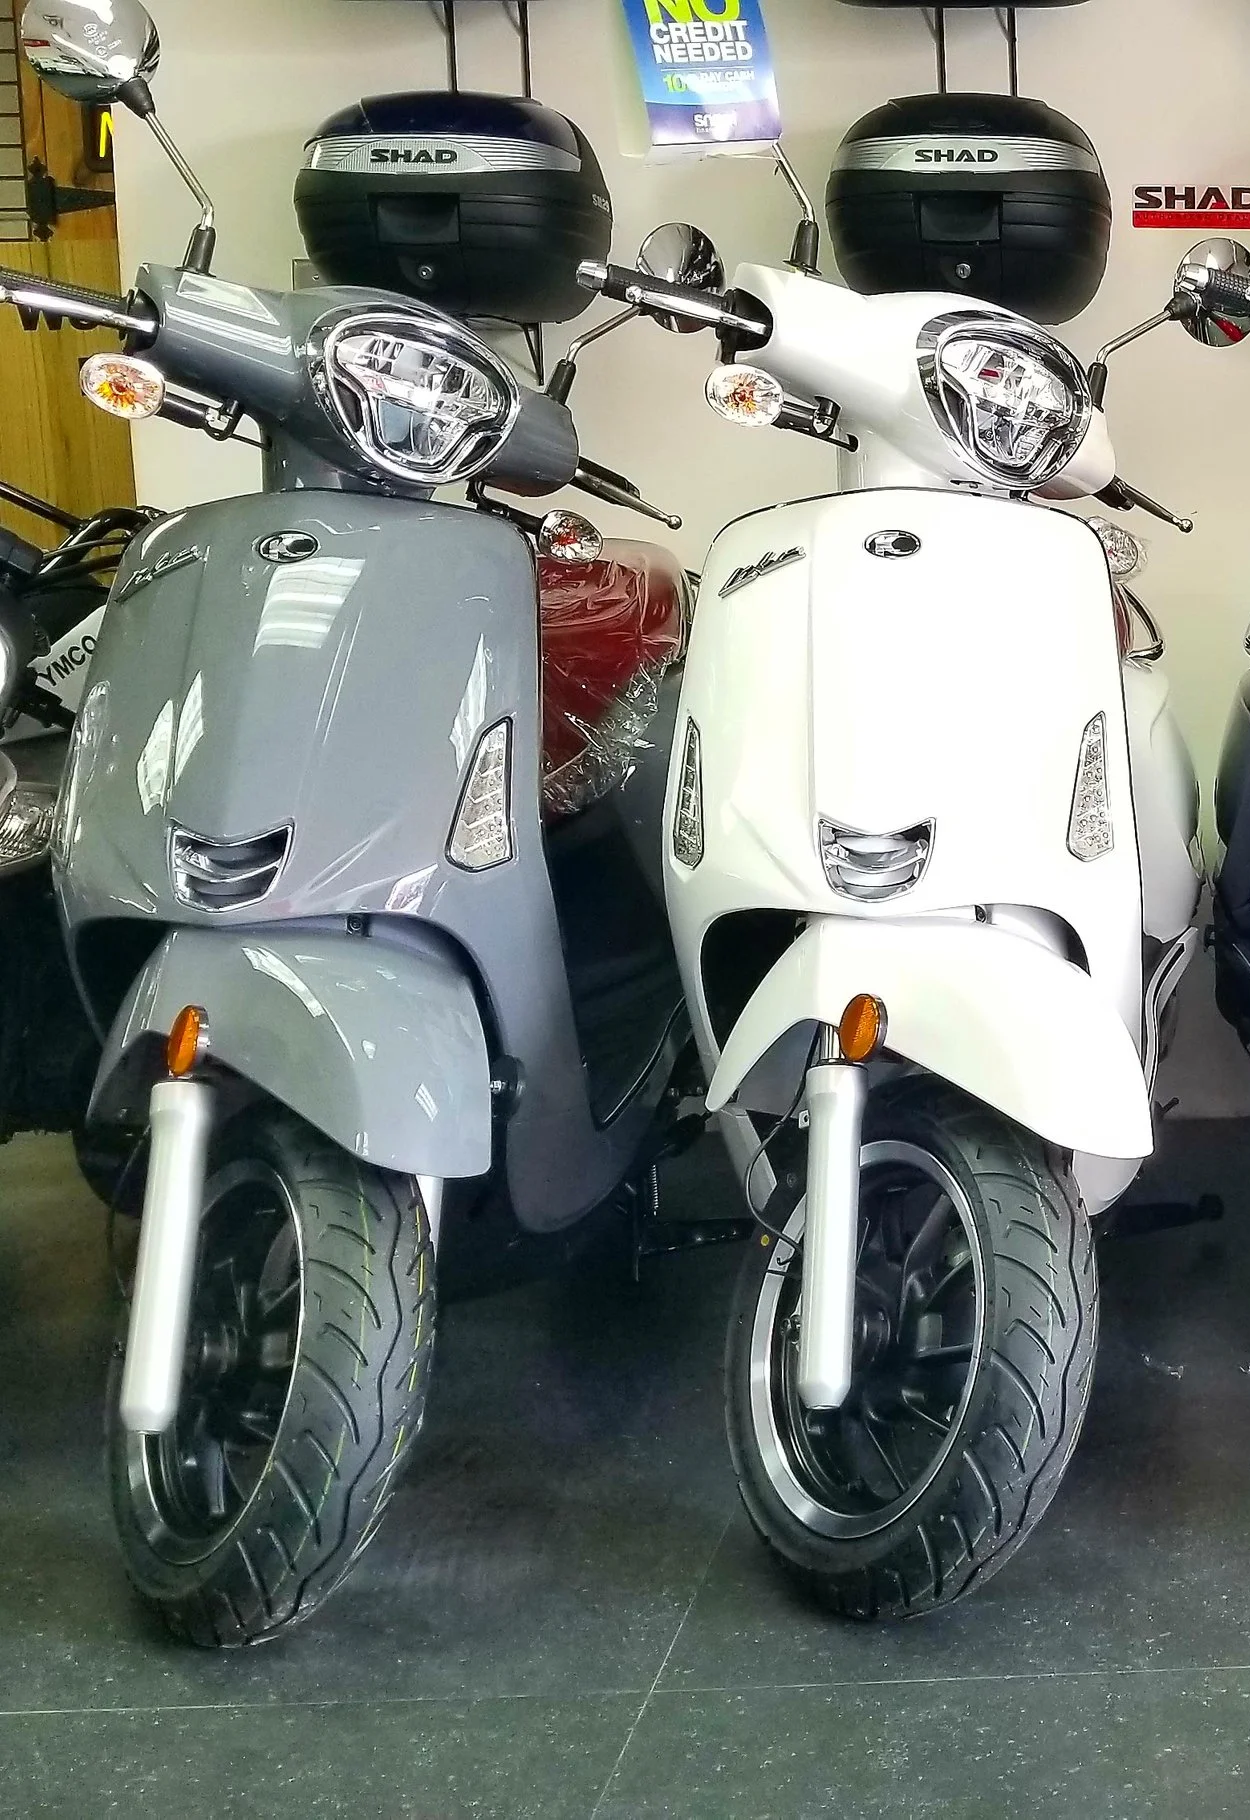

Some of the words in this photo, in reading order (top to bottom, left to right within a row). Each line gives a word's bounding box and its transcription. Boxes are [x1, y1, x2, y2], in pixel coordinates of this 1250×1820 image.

[650, 21, 747, 43] CREDIT
[652, 42, 753, 64] NEEDED
[370, 148, 458, 163] SHAD
[915, 149, 999, 163] SHAD
[37, 635, 97, 686] YMCO
